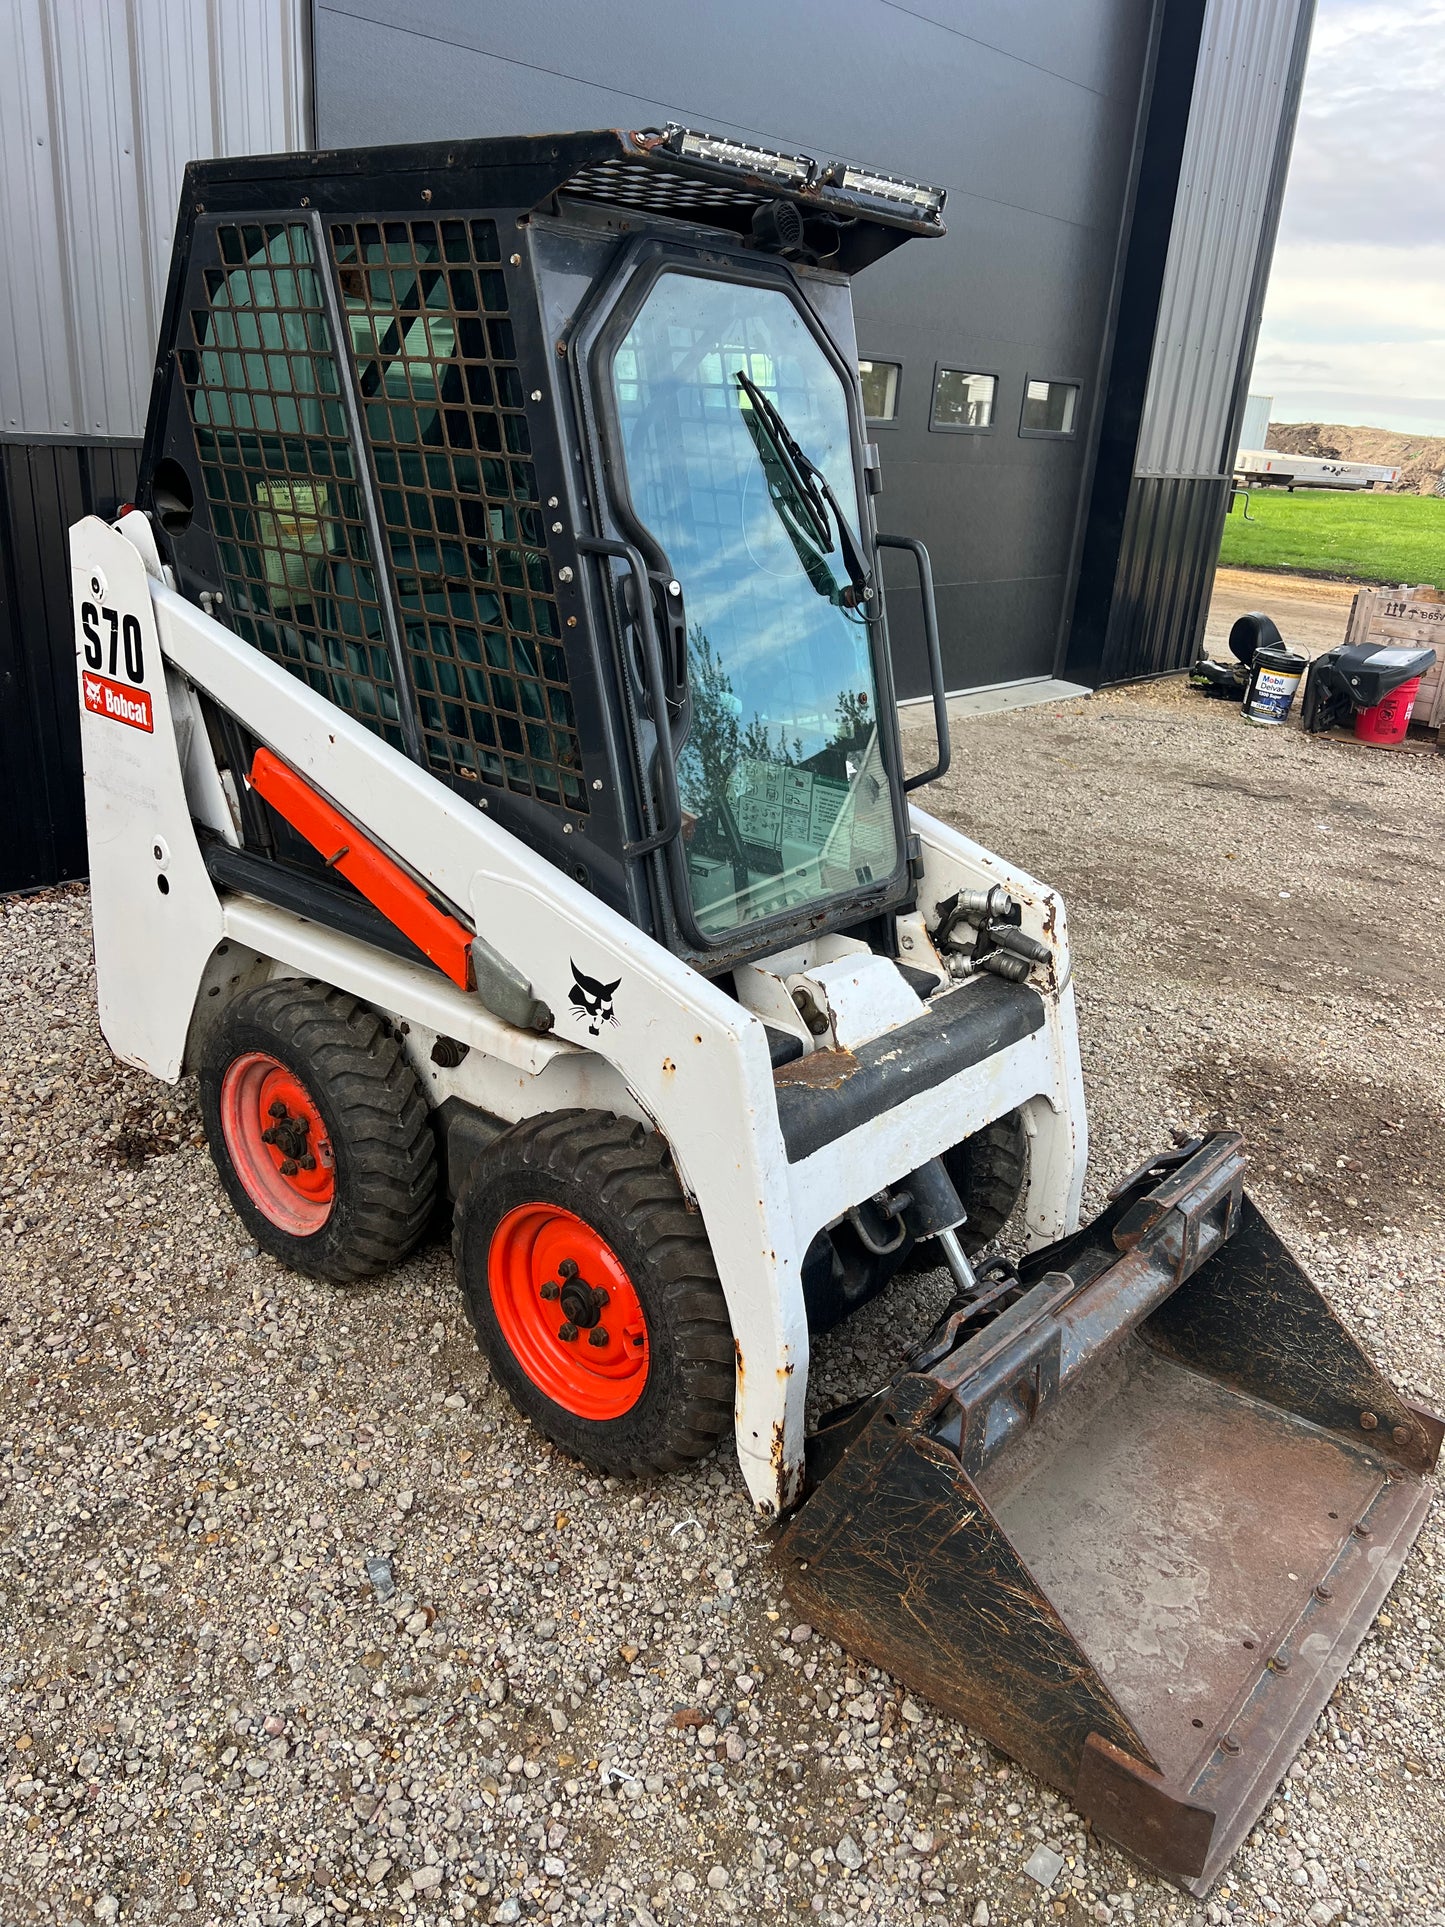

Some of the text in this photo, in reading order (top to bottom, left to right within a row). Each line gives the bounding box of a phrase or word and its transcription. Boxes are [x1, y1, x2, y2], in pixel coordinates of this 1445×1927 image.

[81, 601, 145, 684] S70
[1260, 682, 1285, 693] Delvac
[1262, 675, 1284, 685] Mobil
[104, 687, 148, 726] Bobcat
